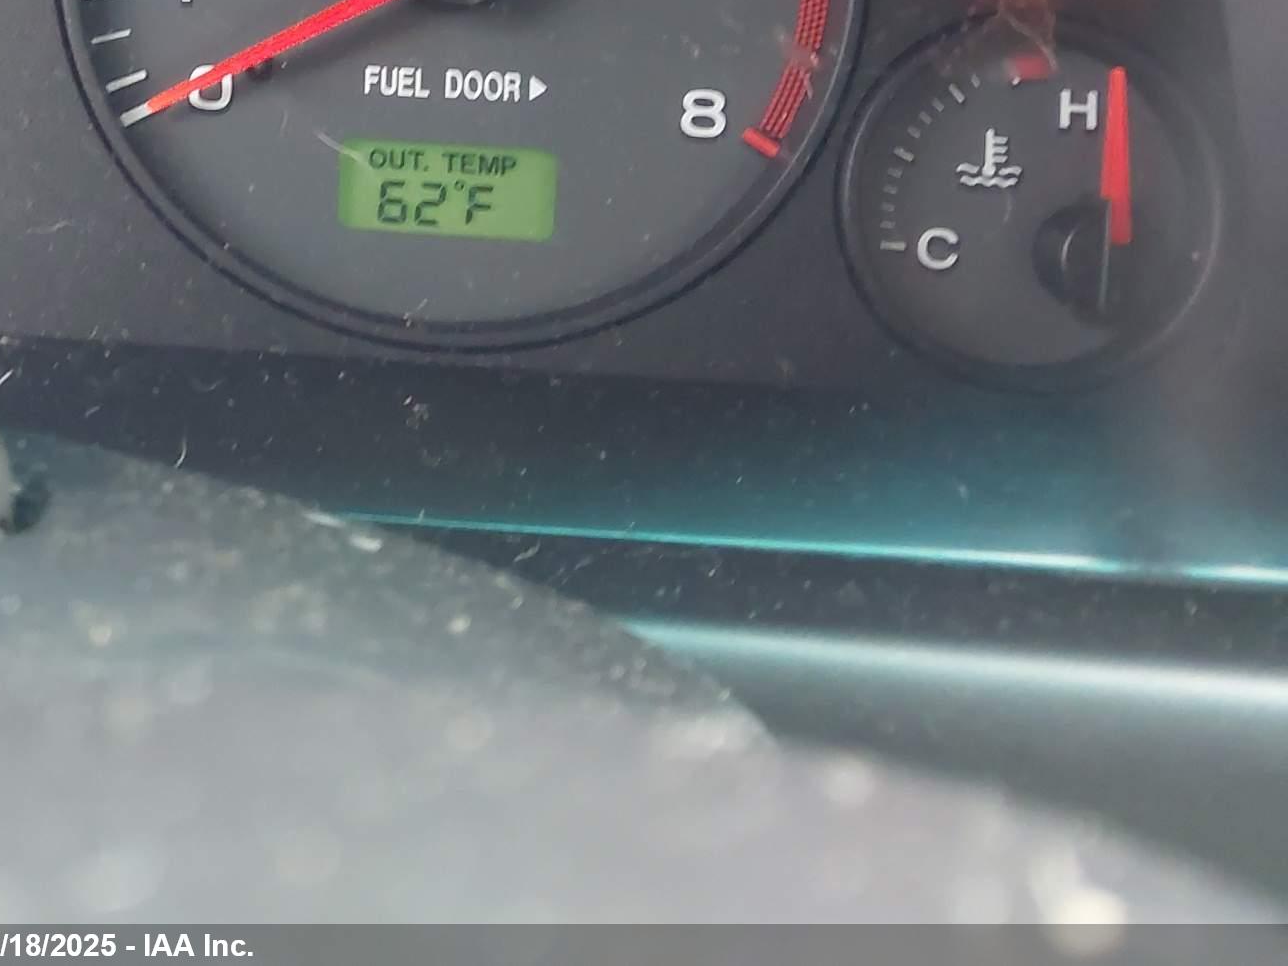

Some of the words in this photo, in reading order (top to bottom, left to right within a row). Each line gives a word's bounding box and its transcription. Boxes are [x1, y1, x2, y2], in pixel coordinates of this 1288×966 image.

[187, 64, 233, 111] 0
[363, 64, 430, 99] FUEL
[444, 67, 521, 102] DOOR
[679, 88, 727, 139] 8
[1058, 88, 1099, 131] H
[368, 147, 430, 173] OUT.
[442, 151, 518, 176] TEMP
[916, 226, 960, 271] C
